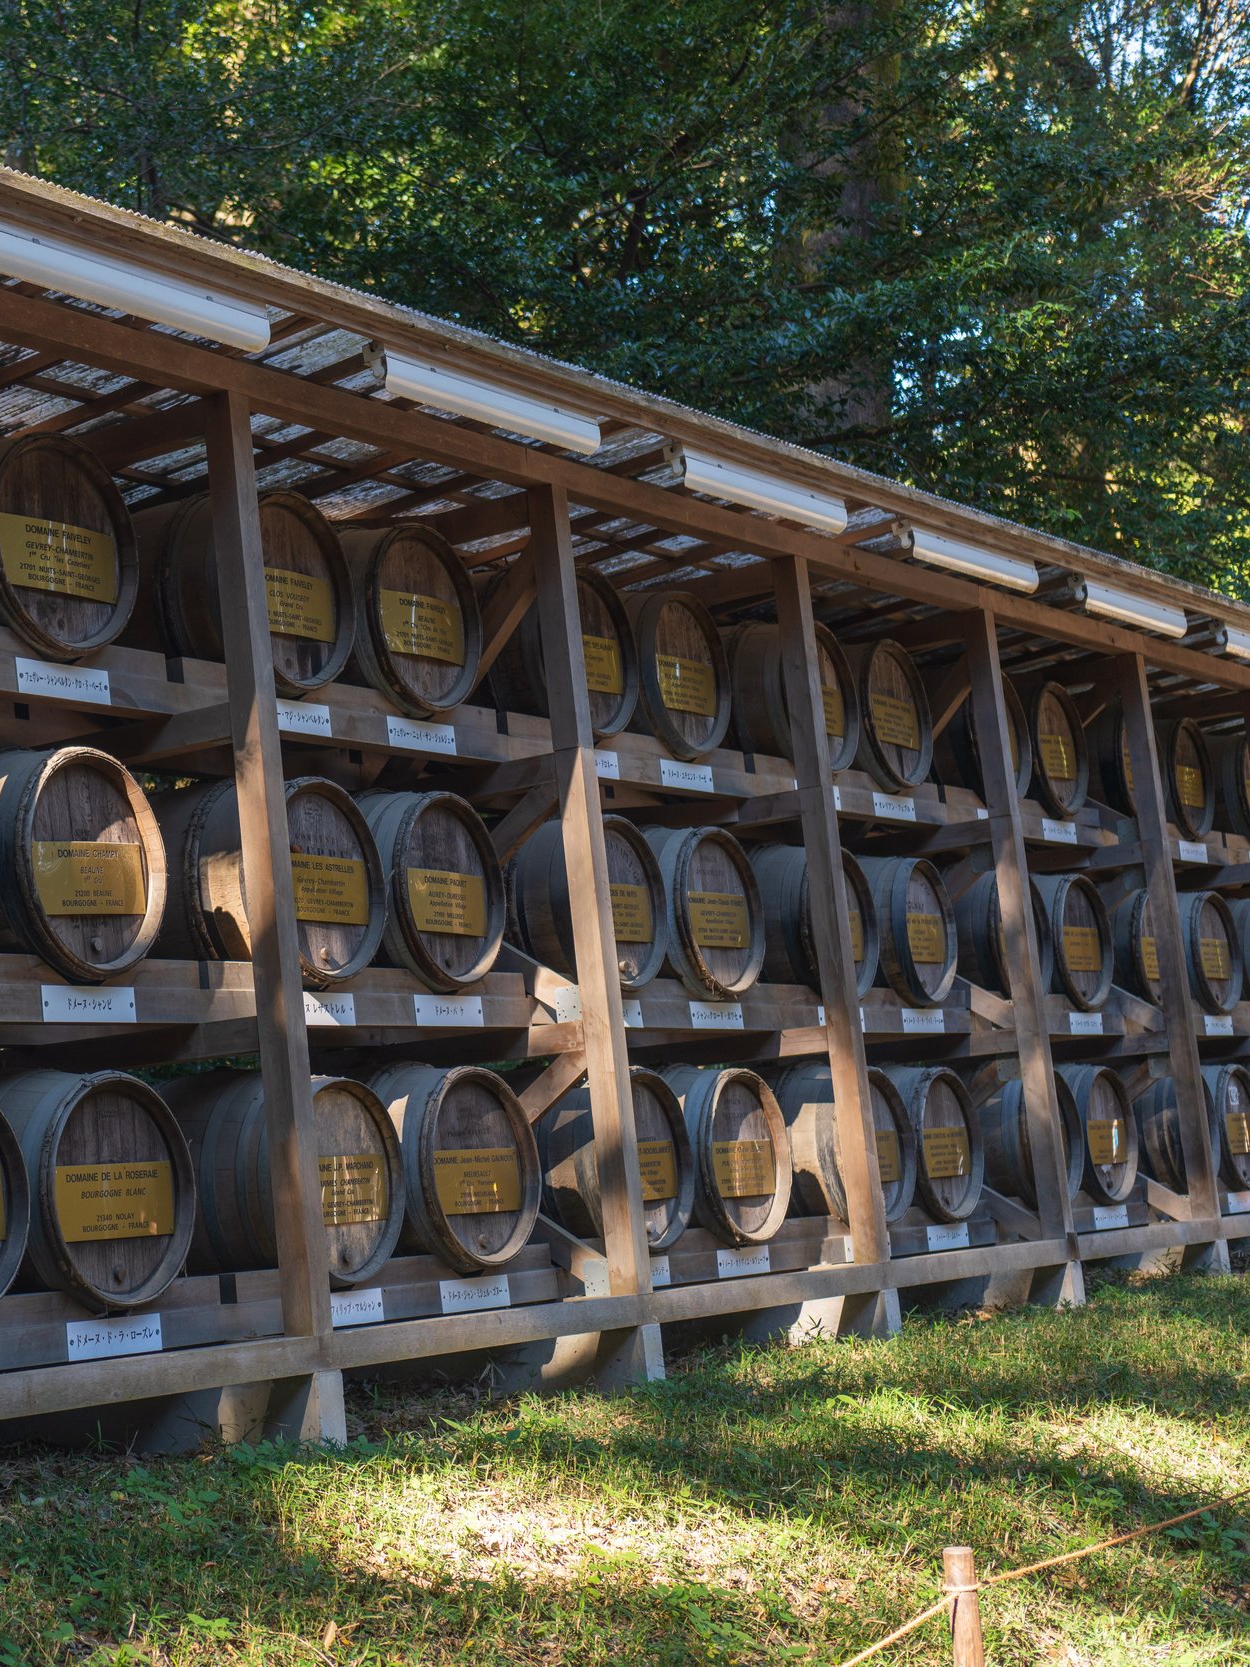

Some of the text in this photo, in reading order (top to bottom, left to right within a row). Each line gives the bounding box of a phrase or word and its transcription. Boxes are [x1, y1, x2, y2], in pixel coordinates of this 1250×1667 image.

[25, 524, 60, 538] DOMAINE
[25, 541, 94, 561] GEVREY-CHAMBERTIN
[28, 573, 95, 592] BOURGOGNE FRANCE
[58, 849, 119, 859] DOMAINE CHAMPY
[424, 875, 449, 885] DOMAINE
[65, 1169, 159, 1183] DOMAINE DE LA ROSERAIE
[81, 1187, 147, 1199] BOURGOGNE BLANC
[115, 1212, 135, 1221] NOLAY
[82, 1221, 150, 1233] BOURGOGNE FRANCE
